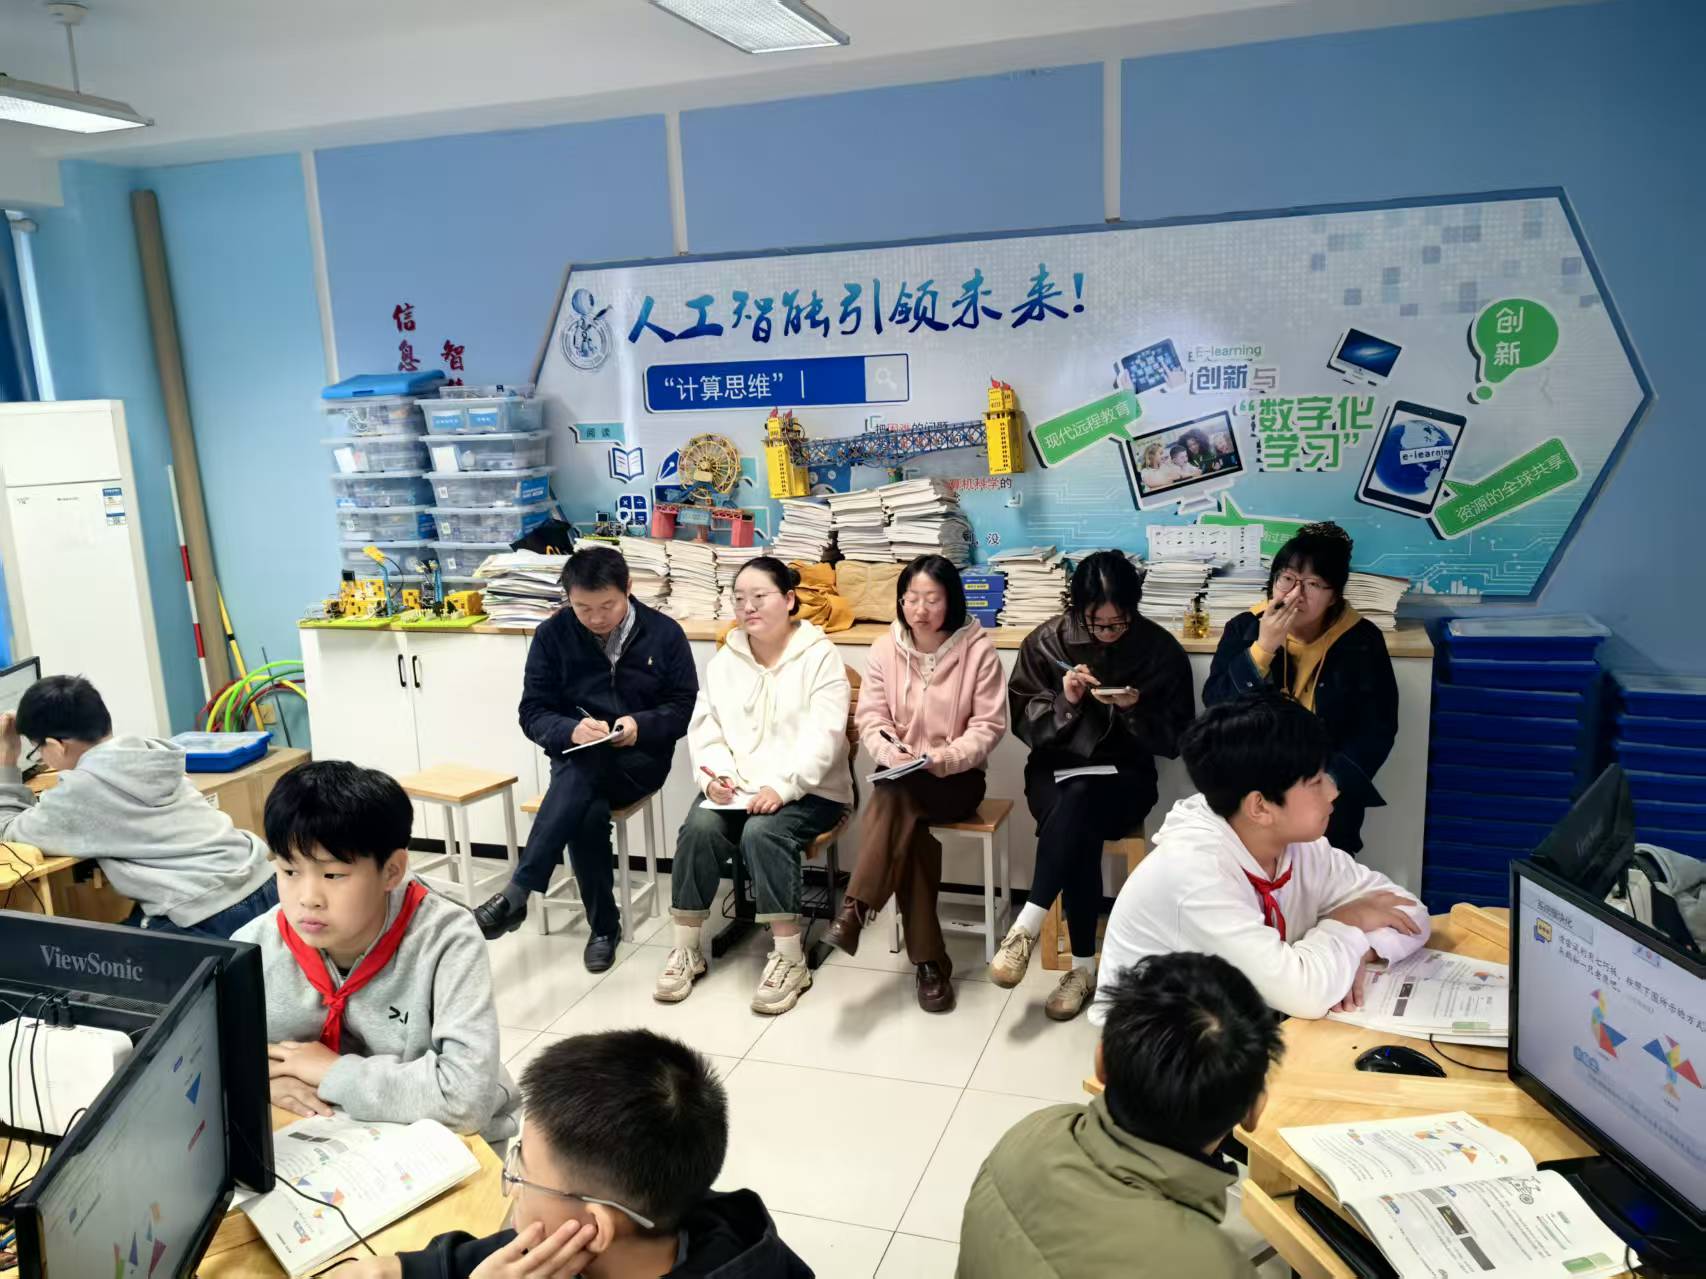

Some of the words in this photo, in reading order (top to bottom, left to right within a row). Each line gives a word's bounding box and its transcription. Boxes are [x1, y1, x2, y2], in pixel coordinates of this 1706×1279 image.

[628, 263, 1086, 344] 人工智能引领未来!
[392, 302, 421, 371] 信息
[1195, 343, 1262, 361] E-learning
[1493, 306, 1524, 365] 创新
[663, 372, 784, 401] “计算思维”
[1196, 364, 1277, 390] 创新与
[586, 427, 611, 439] 阅读
[1044, 401, 1130, 449] 现代远程教育
[1238, 396, 1376, 432] “数字化
[1263, 431, 1360, 469] 学习”
[1402, 449, 1453, 461] e-learnin
[1456, 452, 1566, 523] 资源的全球共享
[40, 944, 144, 982] ViewSonic
